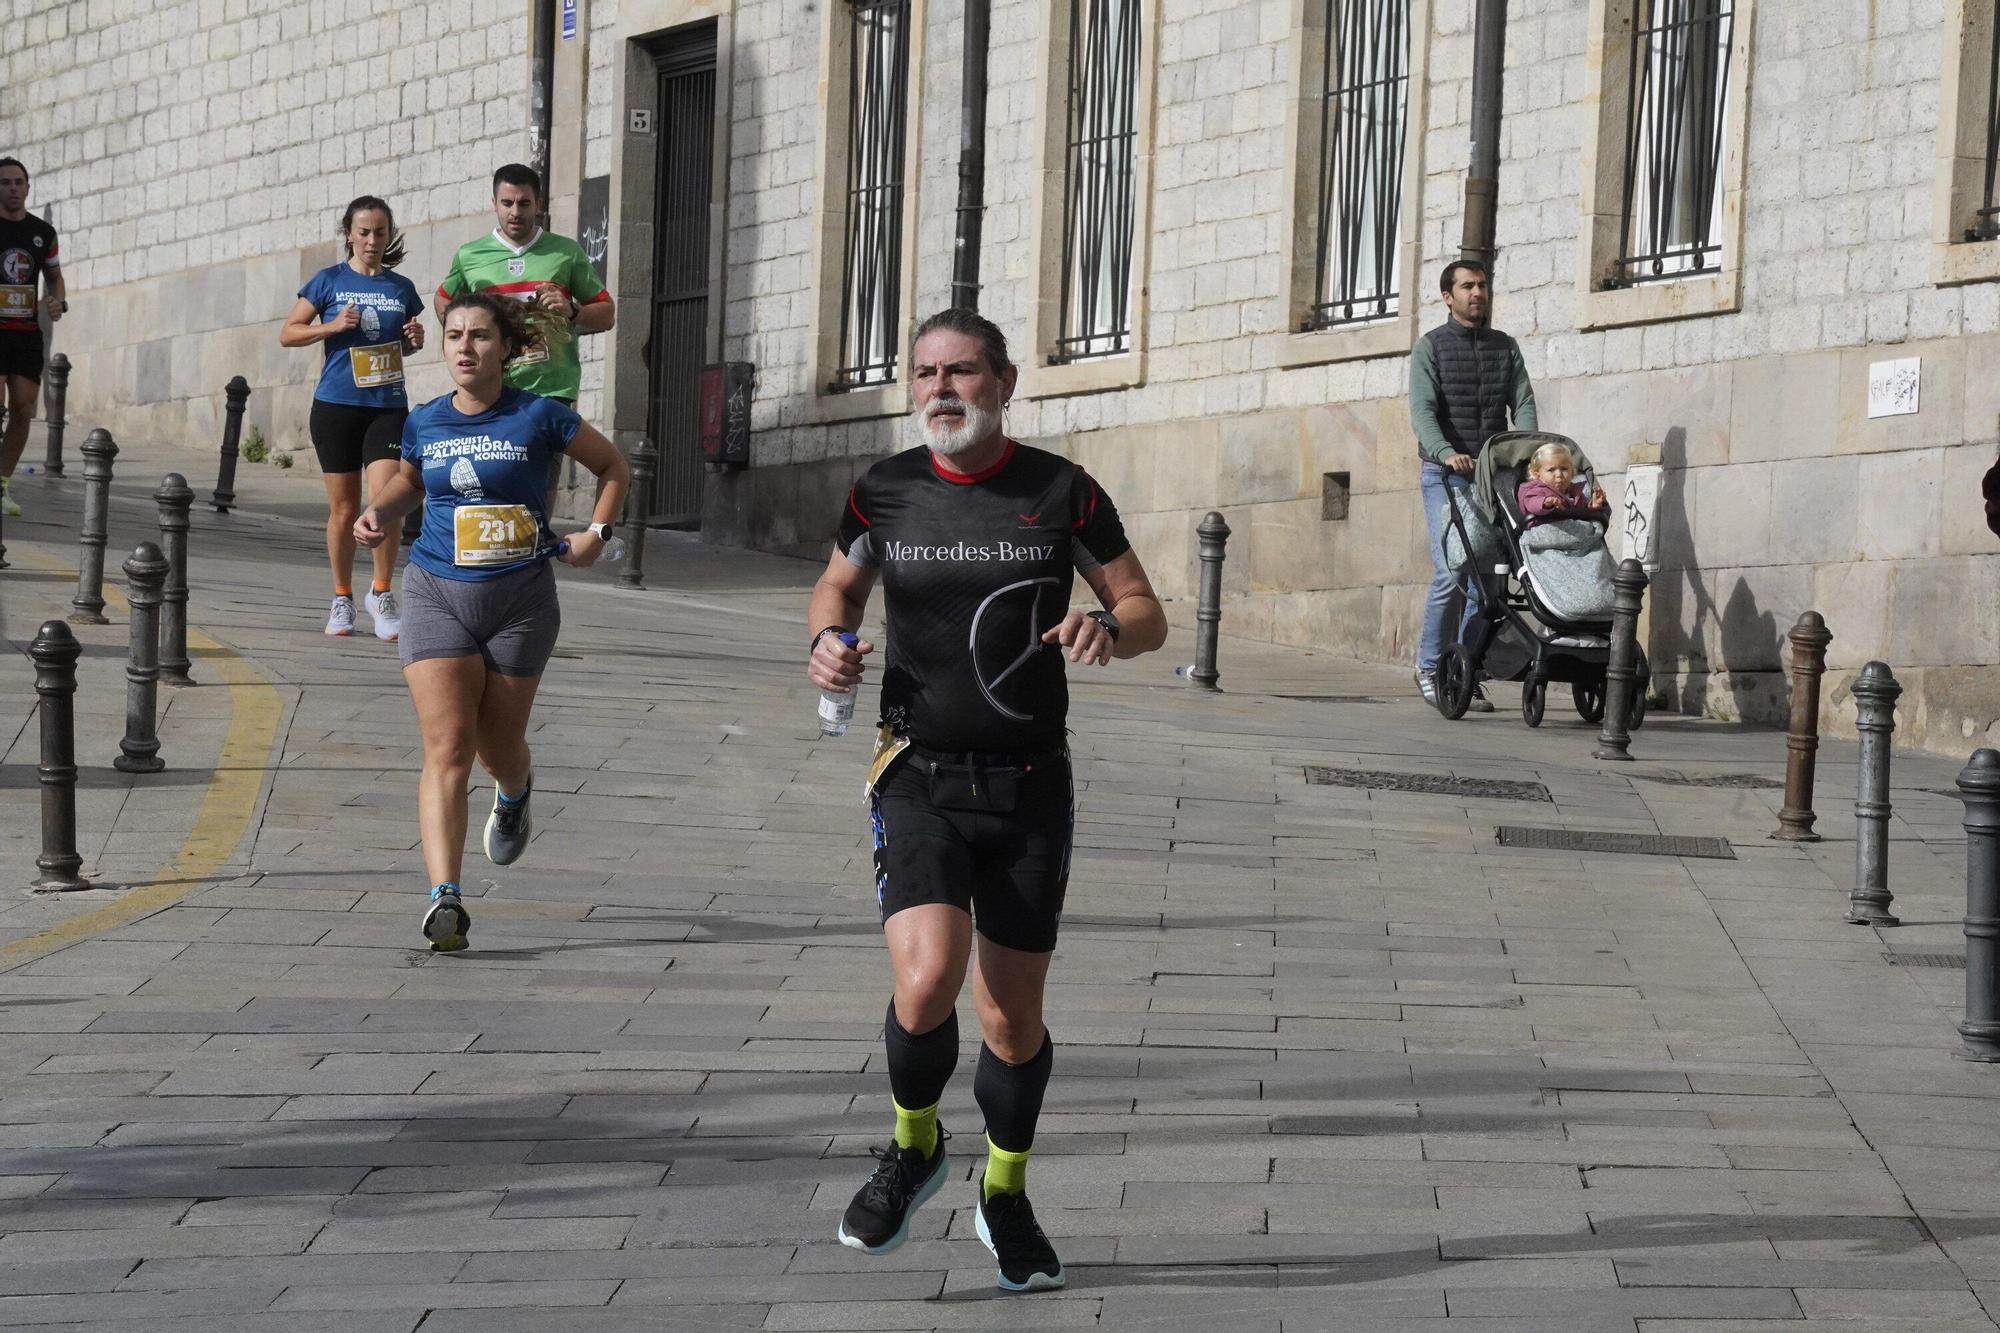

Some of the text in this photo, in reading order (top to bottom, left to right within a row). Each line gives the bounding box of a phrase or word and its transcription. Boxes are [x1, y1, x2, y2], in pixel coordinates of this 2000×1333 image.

[345, 292, 386, 300] CONQUISTA
[347, 298, 400, 306] ALMENDRA
[369, 353, 390, 371] 277
[432, 435, 491, 450] CONQUISTA
[433, 440, 513, 460] ALMENDRA
[474, 451, 529, 462] KONKISTA
[478, 519, 515, 543] 231
[884, 540, 1055, 562] Mercedes-Benz
